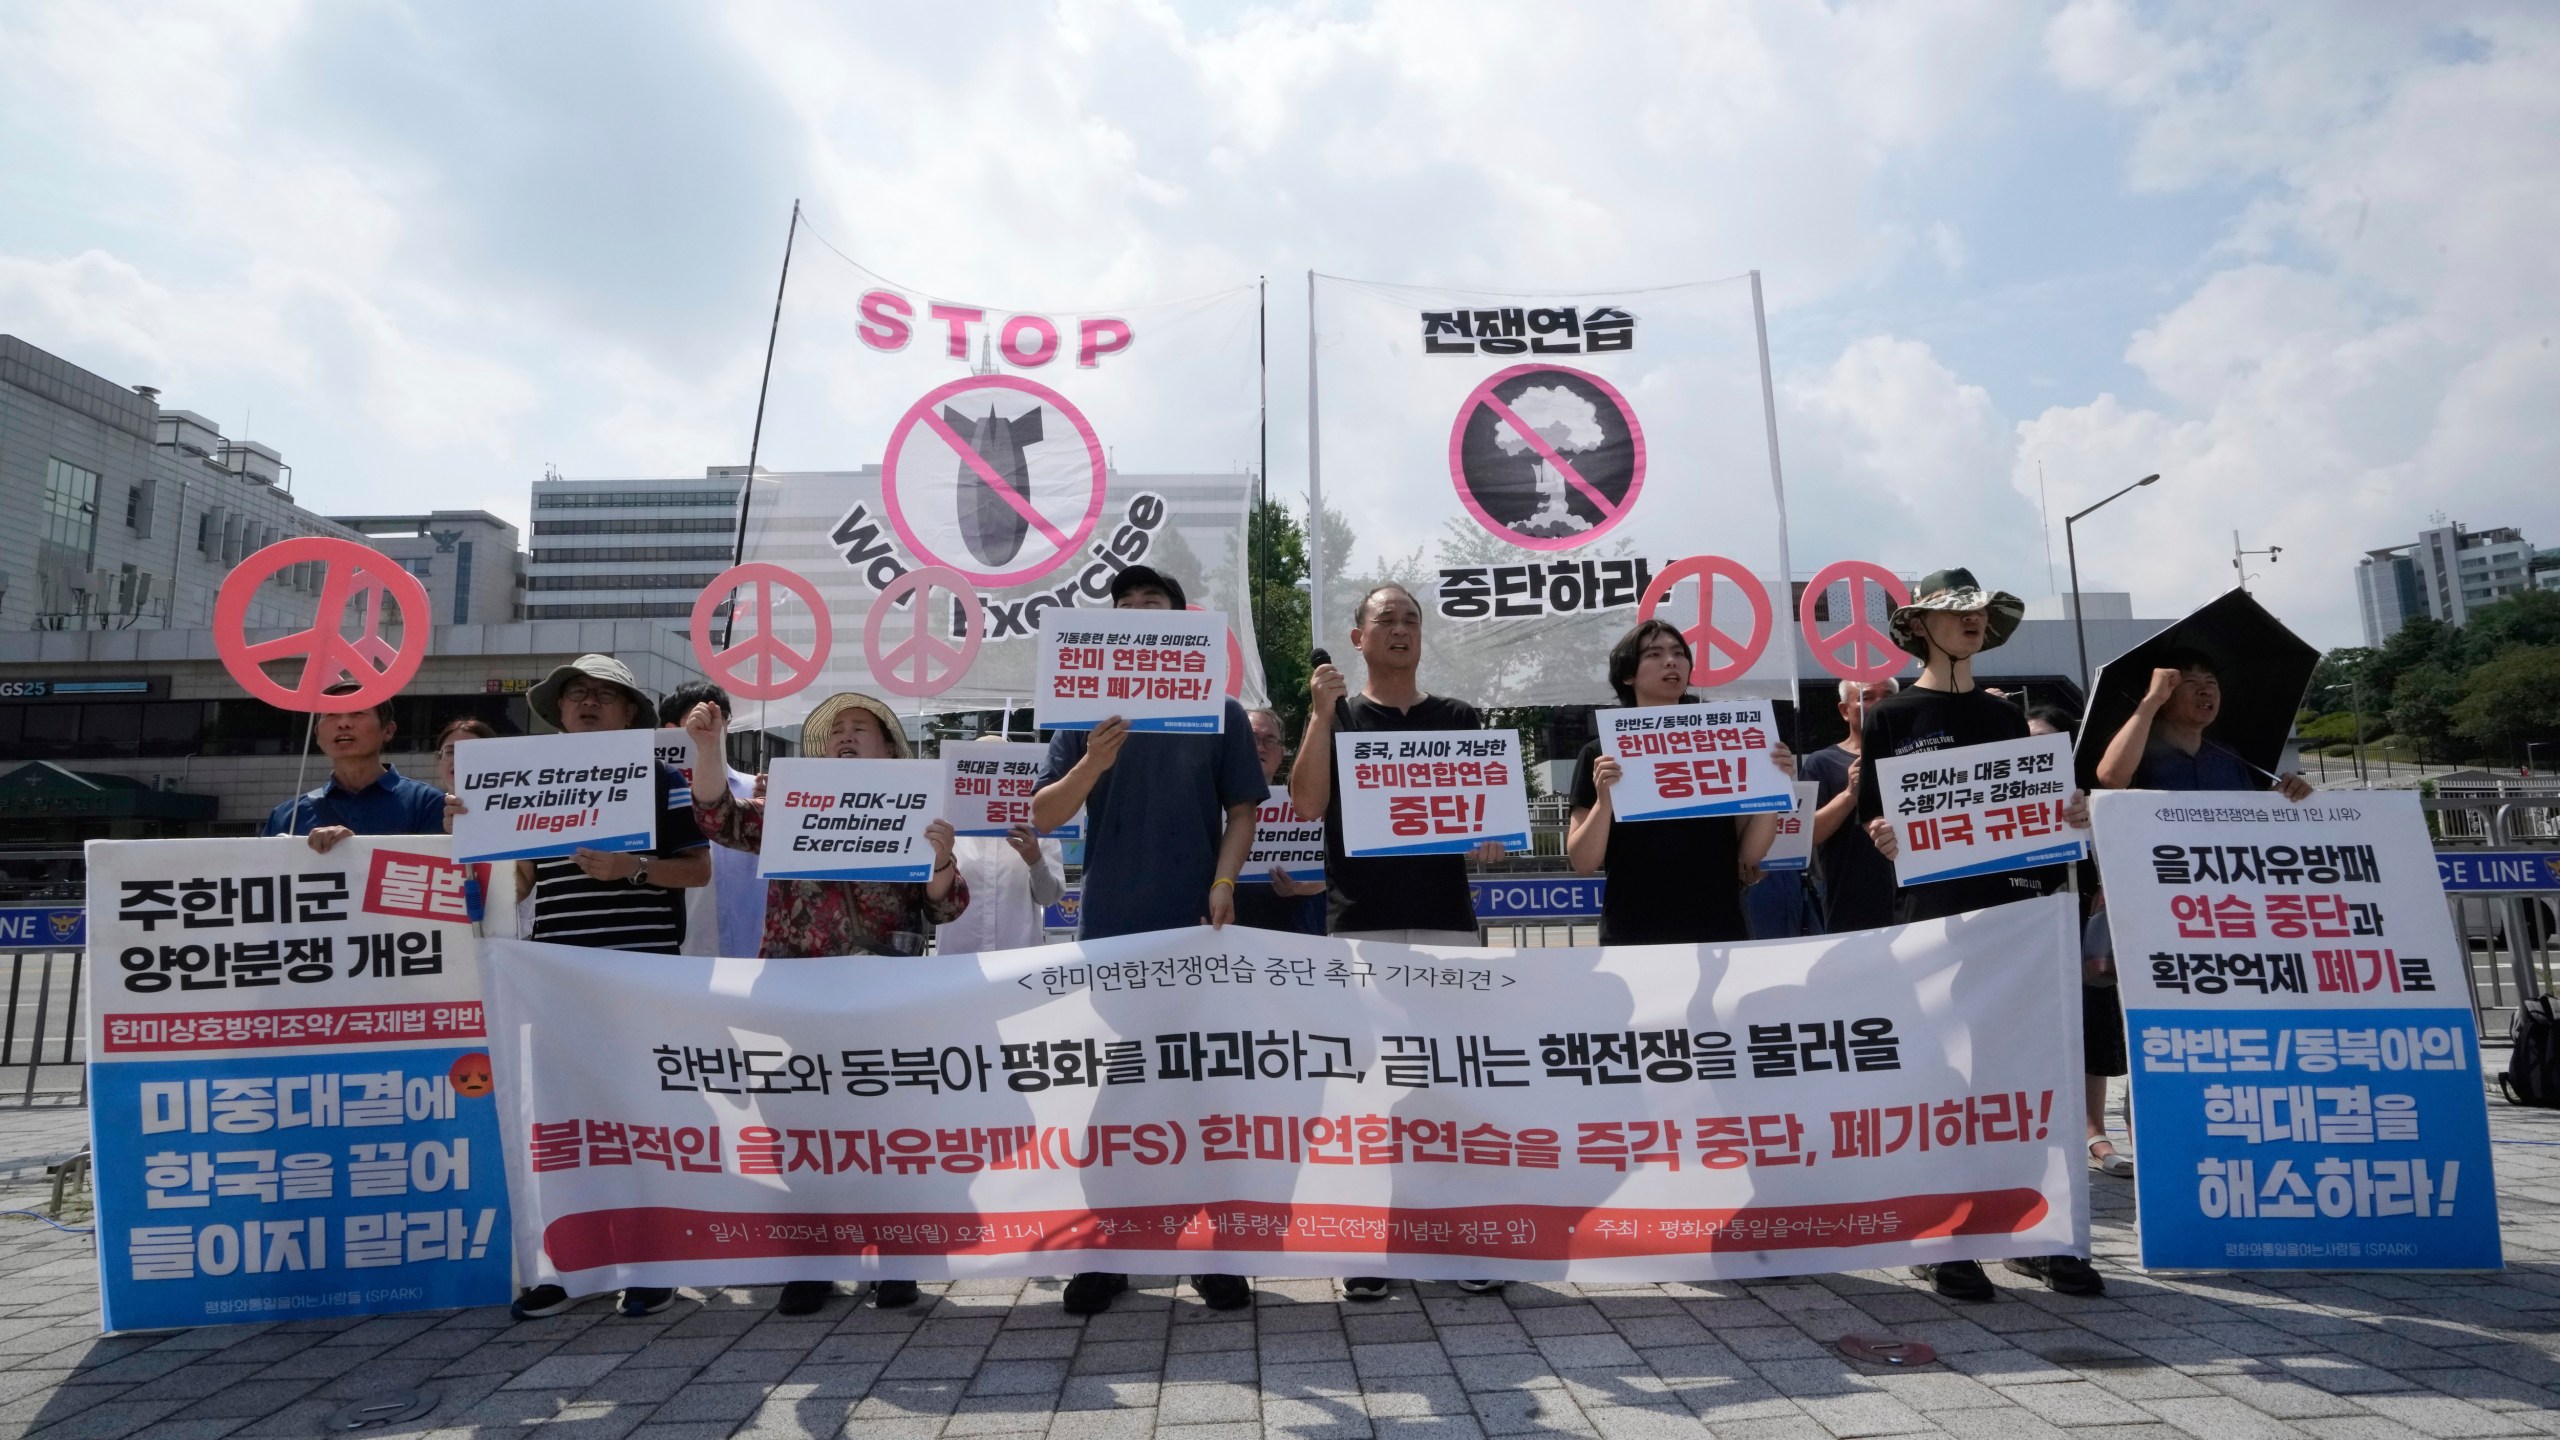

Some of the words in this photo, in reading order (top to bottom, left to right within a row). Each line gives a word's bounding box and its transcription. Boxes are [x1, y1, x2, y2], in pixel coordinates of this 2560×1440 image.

[857, 288, 1134, 368] STOP
[1420, 307, 1635, 355] 전쟁연습
[830, 503, 925, 606] Wa
[1439, 558, 1678, 618] 중단하라
[1056, 632, 1104, 645] 기동훈련
[1106, 633, 1130, 645] 분산
[1133, 634, 1158, 646] 시행
[1160, 635, 1211, 647] 의미없다.
[1058, 647, 1104, 670] 한미
[1113, 649, 1206, 673] 연합연습
[0, 682, 45, 697] GS25
[1053, 676, 1099, 699] 전면
[1106, 677, 1212, 701] 폐기하라!
[1615, 713, 1702, 732] 한반도/동북아
[1705, 711, 1732, 725] 평화
[1735, 710, 1761, 723] 파괴
[1354, 741, 1393, 760] 중국,
[1399, 740, 1451, 758] 러시아
[1456, 739, 1507, 757] 겨냥한
[1616, 727, 1766, 758] 한미연합연습
[464, 770, 533, 790] USFK
[537, 763, 648, 786] Strategic
[955, 777, 991, 796] 한미
[957, 760, 999, 775] 핵대결
[1355, 761, 1508, 789] 한미연합연습
[1653, 757, 1747, 799] 중단!
[1901, 767, 1968, 792] 유엔사를
[1974, 758, 2011, 781] 대중
[2016, 752, 2054, 774] 작전
[485, 788, 603, 811] Flexibility
[607, 786, 628, 803] Is
[785, 791, 836, 812] Stop
[839, 792, 928, 810] ROK-US
[1389, 794, 1486, 836] 중단!
[1898, 788, 1984, 816] 수행기구로
[1990, 780, 2064, 802] 강화하려는
[2154, 807, 2268, 822] <한미연합전쟁연습
[2272, 808, 2300, 822] 반대
[2303, 808, 2323, 822] 1인
[2329, 808, 2361, 822] 시위>
[516, 810, 587, 832] Illegal
[802, 813, 907, 831] Combined
[1907, 813, 1974, 851] 미국
[1984, 799, 2064, 842] 규탄!
[793, 835, 900, 854] Exercises
[2152, 844, 2381, 885] 을지자유방패
[2478, 861, 2536, 882] LINE
[119, 871, 350, 932] 주한미군
[380, 860, 473, 916] 불법
[1491, 887, 1584, 909] POLICE
[2171, 894, 2256, 938] 연습
[2266, 894, 2384, 938] 중단과
[119, 936, 334, 993] 양안분쟁
[348, 930, 444, 979] 개입
[1041, 954, 1256, 995] 한미연합전쟁연습
[1263, 957, 1317, 986] 중단
[1323, 960, 1377, 989] 촉구
[1386, 965, 1491, 992] 기자회견
[2149, 951, 2308, 994] 확장억제
[2312, 949, 2436, 993] 폐기로
[109, 1006, 427, 1046] 한미상호방위조약/국제법
[652, 1044, 833, 1096] 한반도와
[841, 1044, 992, 1097] 동북아
[1001, 1039, 1147, 1094] 평화를
[1155, 1029, 1366, 1085] 파괴하고,
[1381, 1034, 1531, 1088] 끝내는
[1539, 1028, 1737, 1087] 핵전쟁을
[1747, 1017, 1901, 1080] 불러올
[140, 1070, 457, 1135] 미중대결에
[2204, 1084, 2419, 1143] 핵대결을
[530, 1119, 722, 1175] 불법적인
[736, 1117, 1187, 1176] 을지자유방패(UFS)
[1199, 1114, 1561, 1169] 한미연합연습을
[1576, 1119, 1683, 1173] 즉각
[1696, 1113, 1818, 1171] 중단,
[1829, 1090, 2054, 1160] 폐기하라!
[145, 1150, 334, 1210] 한국을
[348, 1138, 471, 1197] 끌어
[2197, 1157, 2460, 1218] 해소하라!
[130, 1216, 326, 1281] 들이지
[344, 1208, 497, 1271] 말라!
[708, 1222, 749, 1243] 일시
[765, 1223, 829, 1243] 2025년
[834, 1223, 866, 1243] 8월
[872, 1222, 949, 1243] 18일(월)
[955, 1222, 997, 1243] 오전
[1002, 1221, 1044, 1240] 11시
[1096, 1217, 1142, 1236] 장소
[1158, 1215, 1201, 1235] 용산
[1208, 1213, 1290, 1236] 대통령실
[1296, 1215, 1452, 1243] 인근(전쟁기념관
[1457, 1221, 1502, 1245] 정문
[1506, 1221, 1536, 1245] 앞)
[1594, 1218, 1638, 1240] 주최
[1659, 1211, 1902, 1240] 평화와통일을여는사람들
[2225, 1242, 2361, 1257] 평화와통일을여는사람들
[2364, 1242, 2418, 1256] (SPARK)
[366, 1286, 423, 1303] (SPARK)
